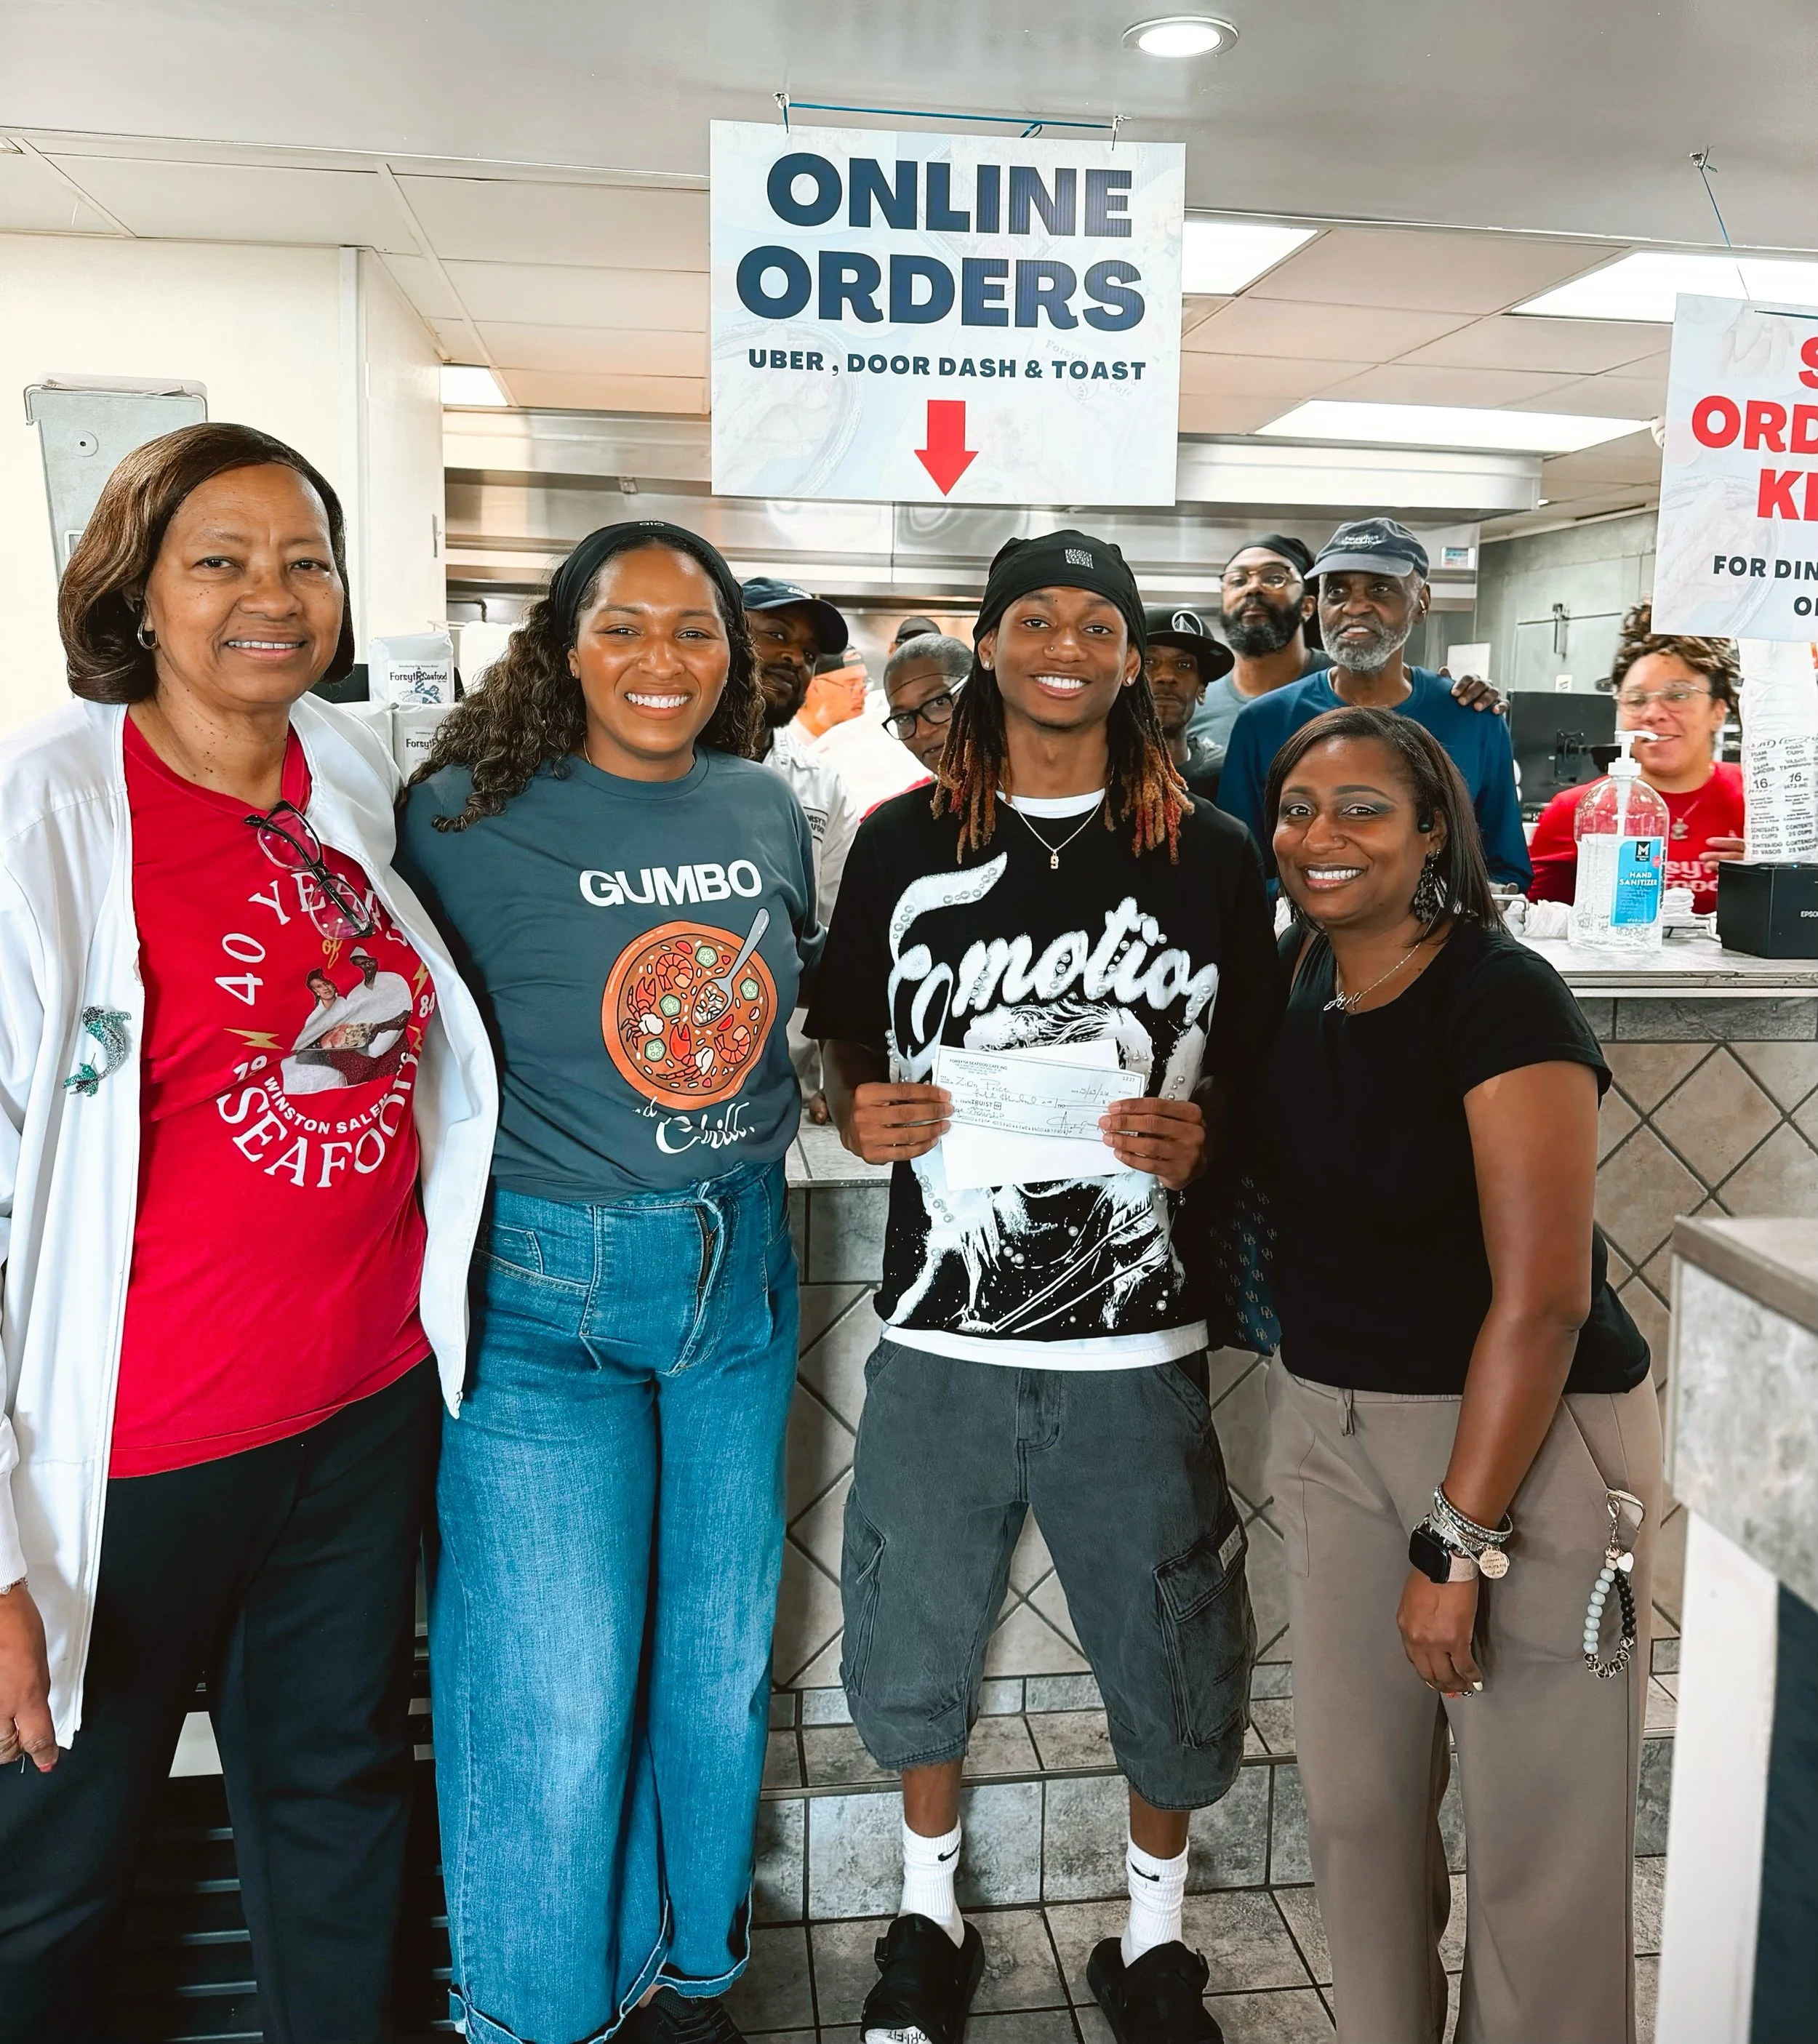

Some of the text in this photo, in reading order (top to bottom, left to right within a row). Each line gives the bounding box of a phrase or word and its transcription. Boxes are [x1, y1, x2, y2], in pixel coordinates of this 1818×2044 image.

[766, 152, 1132, 237] ONLINE
[736, 245, 1146, 332] ORDERS
[847, 353, 930, 376] DOOR
[938, 357, 1017, 378] DASH
[1025, 360, 1043, 378] &
[1052, 361, 1146, 380] TOAST
[1713, 556, 1766, 577] FOR
[1753, 772, 1802, 789] 16 16
[579, 859, 763, 907] GUMBO
[215, 933, 266, 1006] 40
[419, 992, 435, 1018] 84
[264, 1076, 330, 1134] WINSTON
